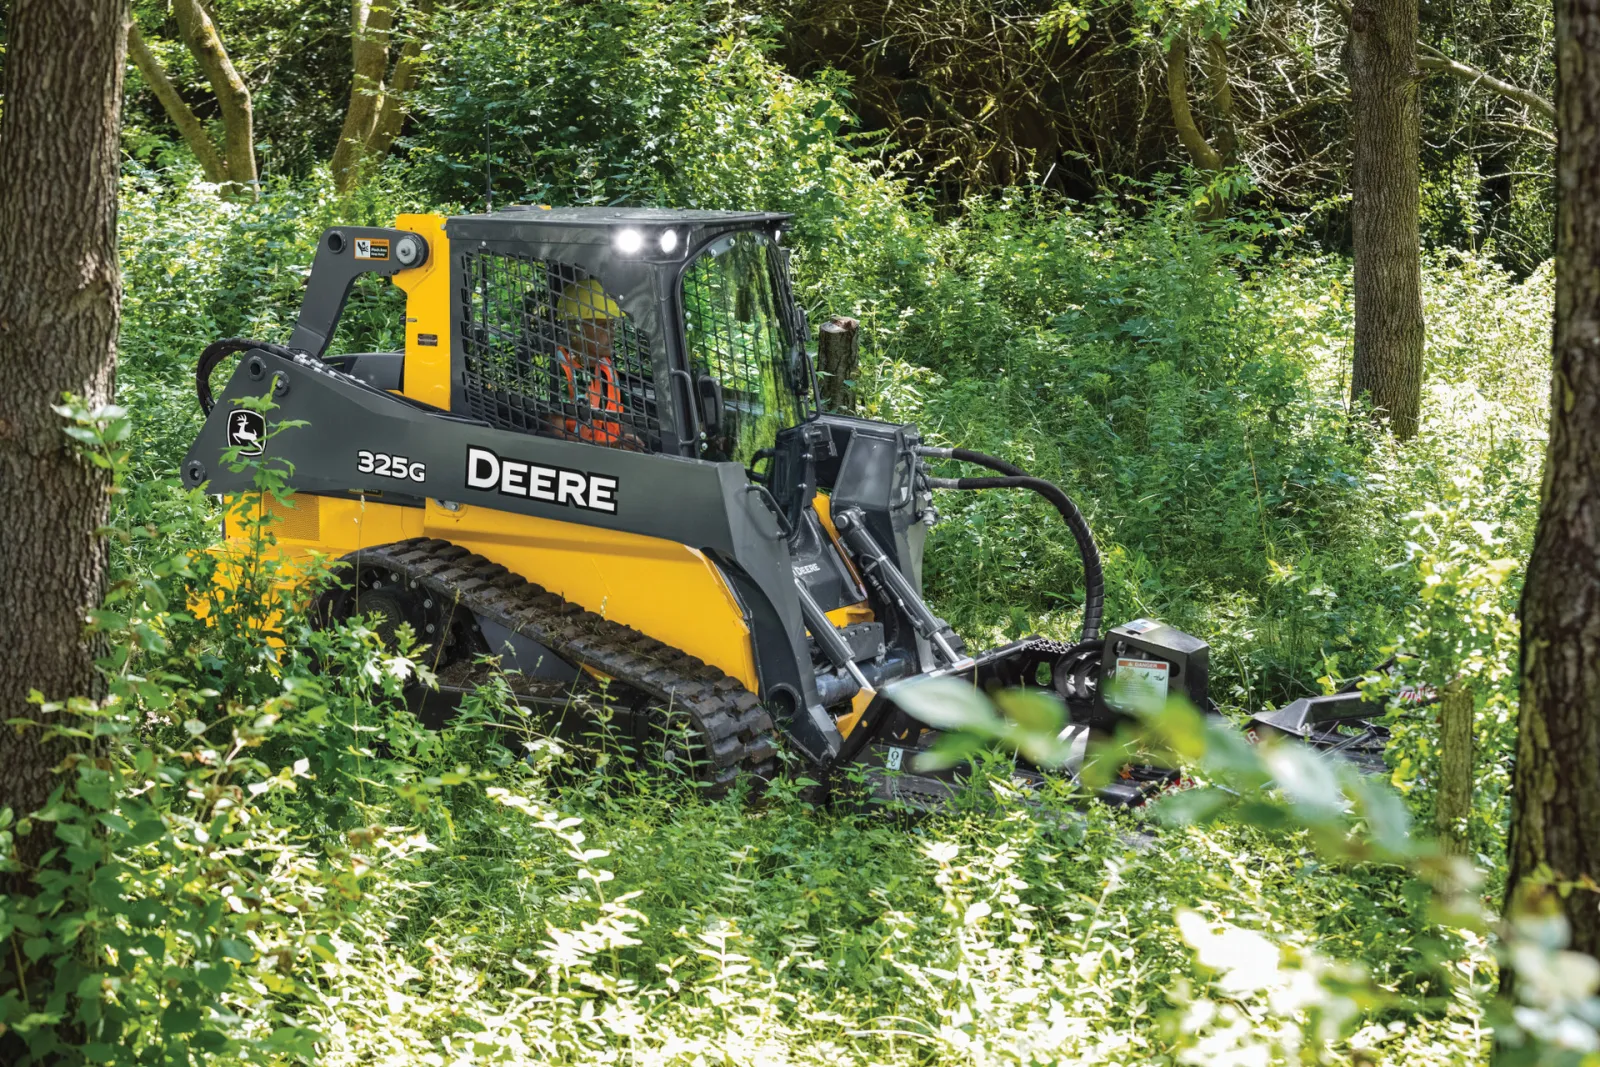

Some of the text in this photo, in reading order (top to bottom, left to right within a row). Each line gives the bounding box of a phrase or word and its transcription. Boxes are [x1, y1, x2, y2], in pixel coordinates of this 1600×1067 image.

[357, 450, 426, 483] 325G
[466, 446, 618, 513] DEERE
[794, 563, 820, 575] DEERE
